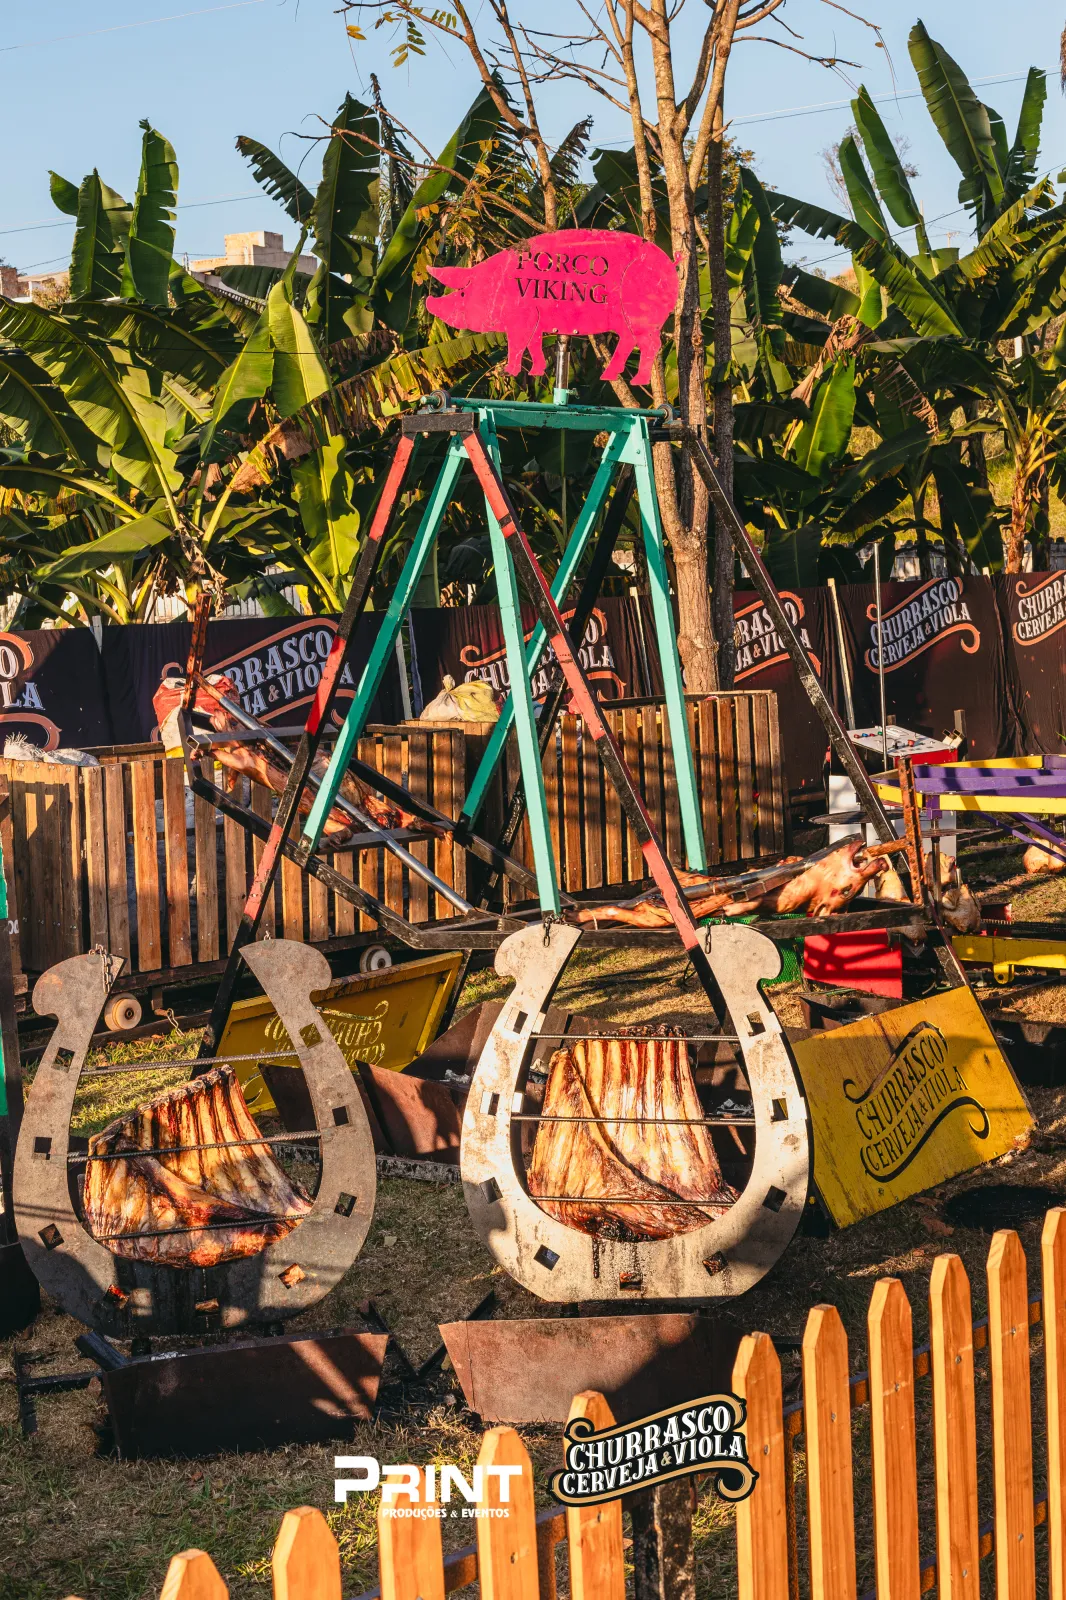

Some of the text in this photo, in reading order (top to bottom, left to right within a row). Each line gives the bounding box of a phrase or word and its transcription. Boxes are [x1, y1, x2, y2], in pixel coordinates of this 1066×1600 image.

[515, 277, 609, 304] VIKING
[516, 250, 609, 277] PORCO
[870, 580, 959, 647] CHURRASCO
[1017, 601, 1066, 639] CERVEJA
[1018, 574, 1066, 621] CHURR
[870, 628, 926, 667] CERVEJA
[929, 602, 973, 633] VIOLA
[856, 1035, 945, 1140] CHURRASCO
[865, 1103, 925, 1171] CERVEJA
[920, 1065, 970, 1111] VIOLA
